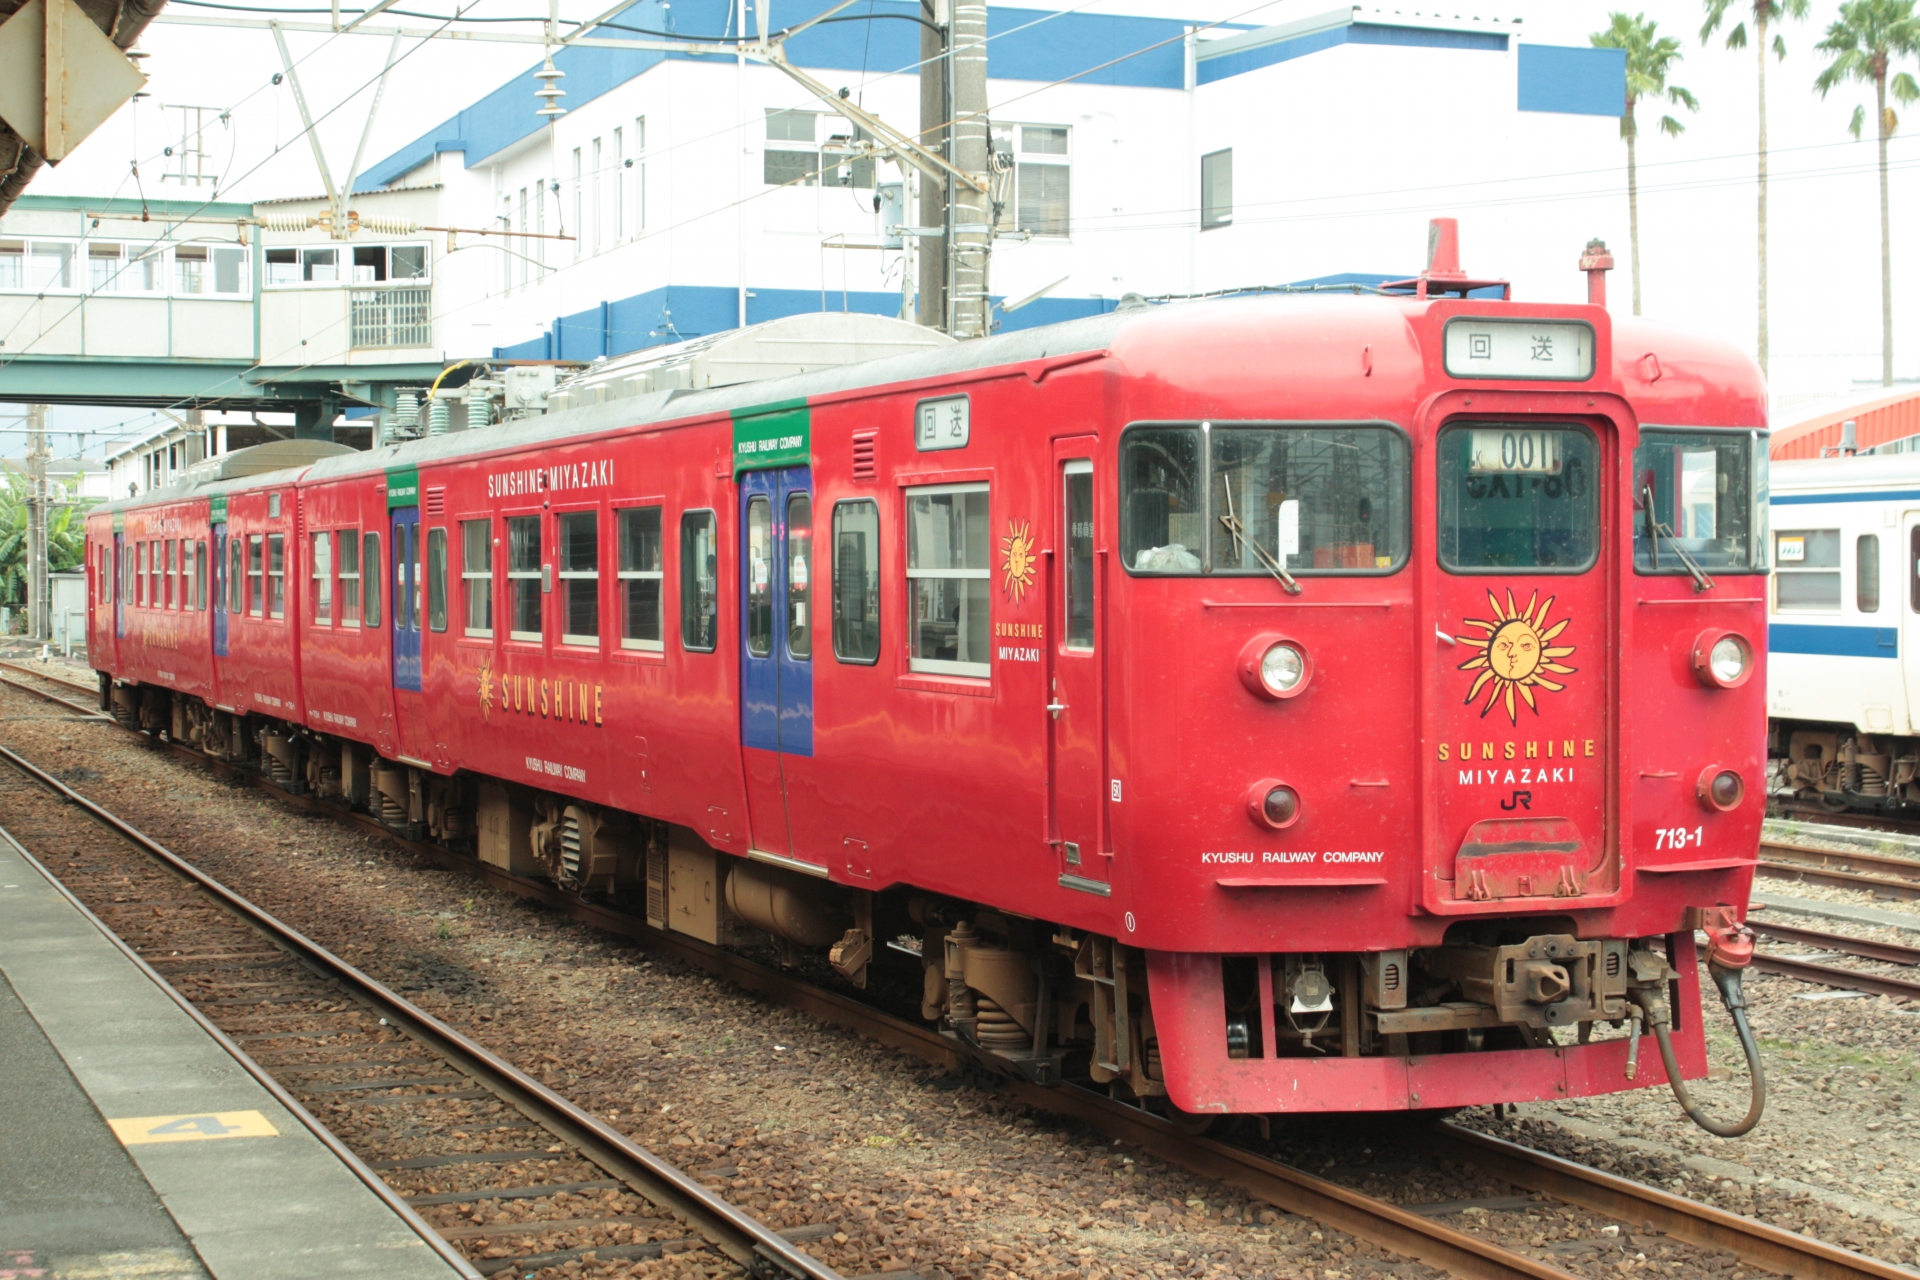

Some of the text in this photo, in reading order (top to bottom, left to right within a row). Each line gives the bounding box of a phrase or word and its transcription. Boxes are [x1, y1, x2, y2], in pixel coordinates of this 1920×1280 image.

[1469, 333, 1553, 361] 回送
[924, 404, 962, 440] 回送
[779, 435, 803, 449] COMPANY
[488, 459, 614, 498] SUNSHINE MIYAZAKI
[995, 622, 1043, 639] SUNSHINE
[998, 646, 1039, 662] MIYAZAKI
[502, 673, 603, 727] SUNSHINE
[1438, 740, 1595, 762] SUNSHINE
[1459, 768, 1574, 785] MIYAZAKI
[1500, 791, 1532, 811] JR
[1655, 825, 1703, 850] 713-1
[1202, 851, 1384, 863] KYUSHU RAILWAY COMPANY
